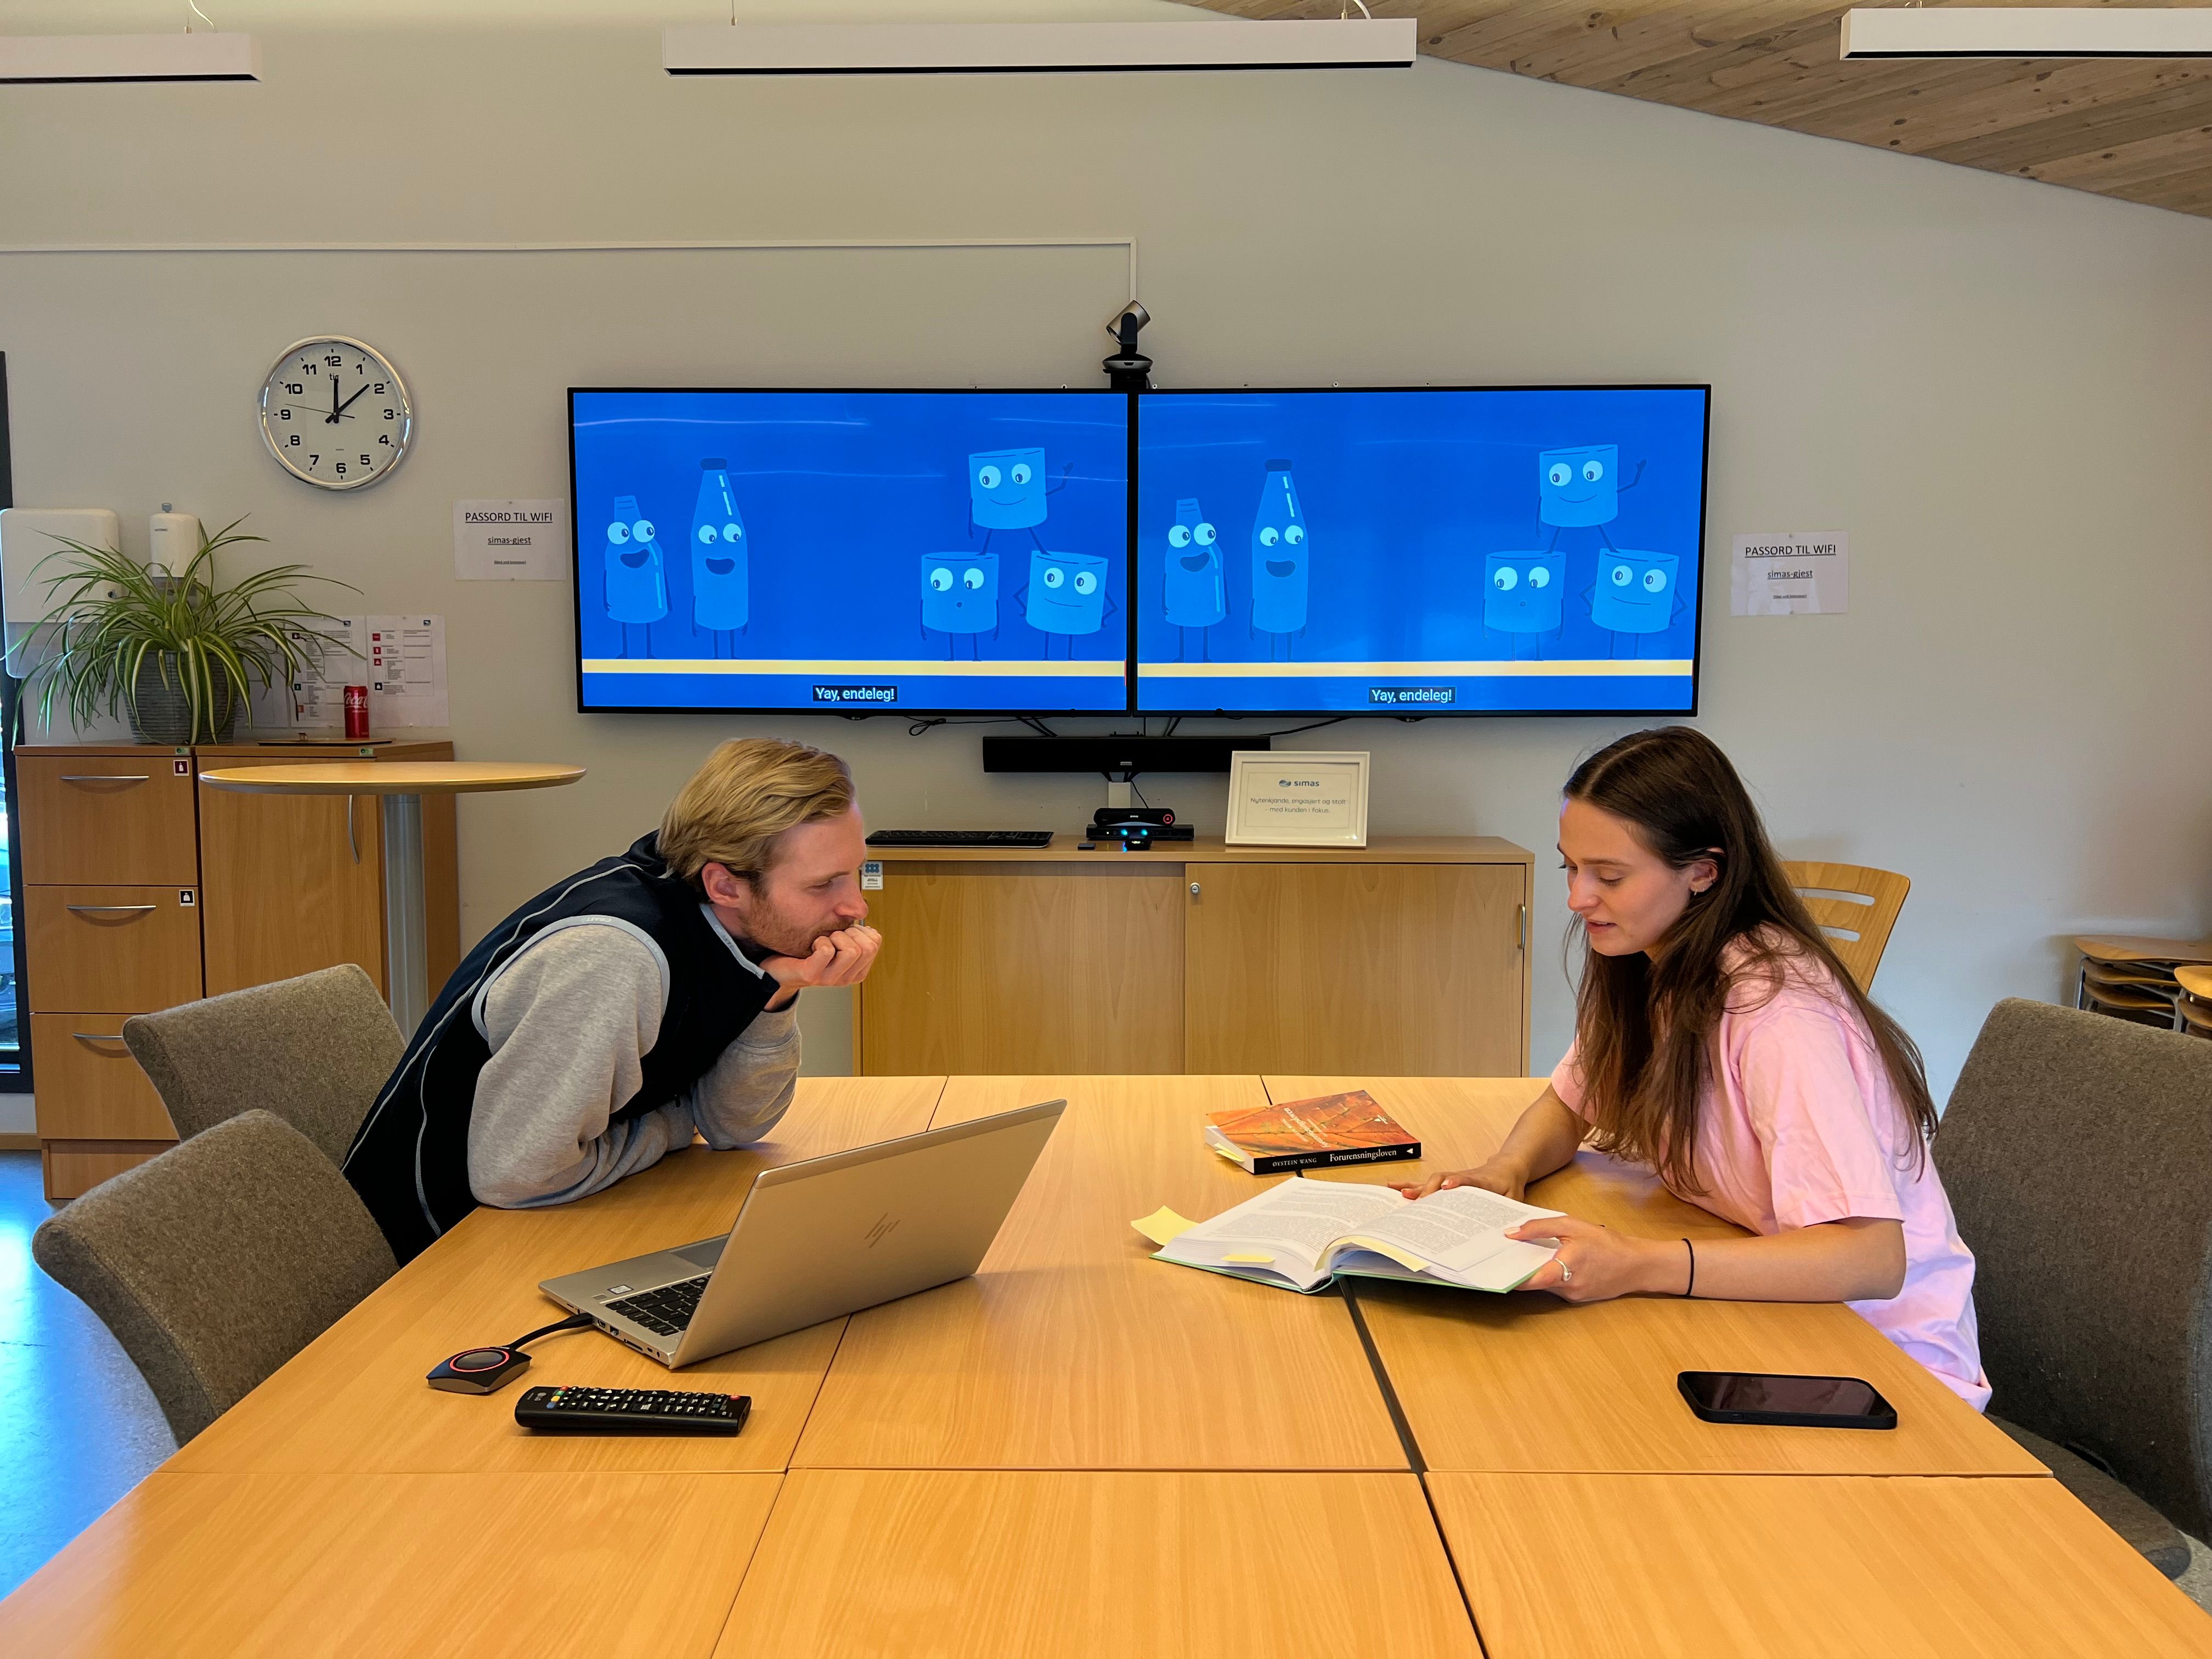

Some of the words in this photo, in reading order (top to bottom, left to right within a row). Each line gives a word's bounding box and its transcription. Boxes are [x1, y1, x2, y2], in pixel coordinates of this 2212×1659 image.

[324, 356, 341, 366] 12
[302, 364, 317, 375] 11
[356, 365, 363, 375] 1
[285, 383, 303, 394] 10
[374, 383, 385, 394] 2
[281, 409, 291, 420] 9
[383, 409, 394, 420] 3
[290, 435, 300, 445] 8
[379, 435, 389, 445] 4
[309, 455, 319, 465] 7
[360, 455, 370, 465] 5
[336, 463, 346, 473] 6
[465, 512, 511, 522] PASSORD
[514, 512, 528, 522] TIL
[531, 512, 552, 522] WIFI
[488, 537, 531, 545] simas-gjest
[1745, 545, 1792, 556] PASSORD
[1796, 545, 1810, 555] TIL
[1813, 544, 1836, 554] WIFI
[1768, 569, 1813, 578] simas-gjest
[815, 687, 840, 702] Yay,
[843, 687, 895, 702] endeleg!
[1372, 689, 1396, 704] Yay,
[1399, 689, 1452, 703] endeleg!
[1330, 1149, 1397, 1162] Forurensningsloven
